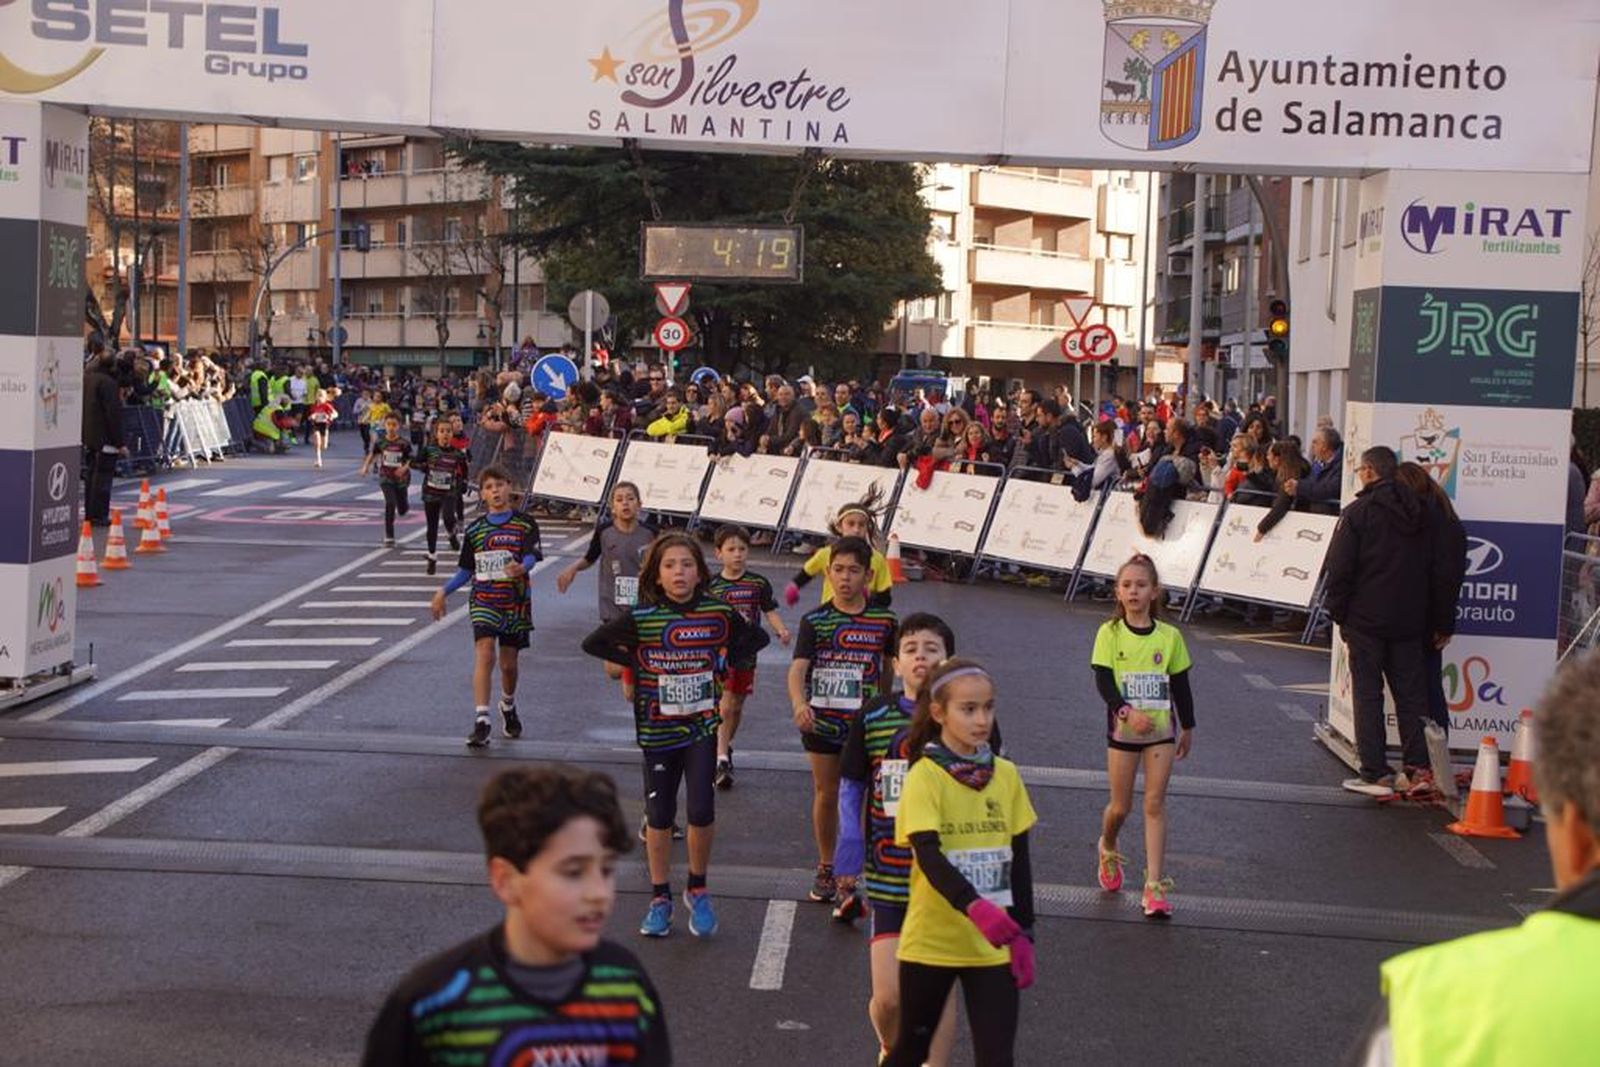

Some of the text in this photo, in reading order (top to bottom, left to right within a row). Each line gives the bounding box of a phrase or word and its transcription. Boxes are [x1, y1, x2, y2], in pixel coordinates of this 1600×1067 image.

[31, 0, 308, 56] SETEL
[204, 54, 308, 83] Grupo
[1217, 50, 1507, 94] Ayuntamiento
[588, 110, 849, 143] SALMANTINA
[1216, 98, 1502, 140] de Salamanca
[1482, 240, 1561, 254] fertilizantes
[662, 328, 681, 340] 30
[1462, 449, 1558, 466] San Estanislao
[1462, 464, 1526, 480] de Kostka
[480, 556, 504, 571] 5720
[1459, 582, 1518, 601] NDAI
[666, 685, 702, 702] 5985
[817, 679, 849, 695] 5774
[1127, 681, 1160, 697] 6008
